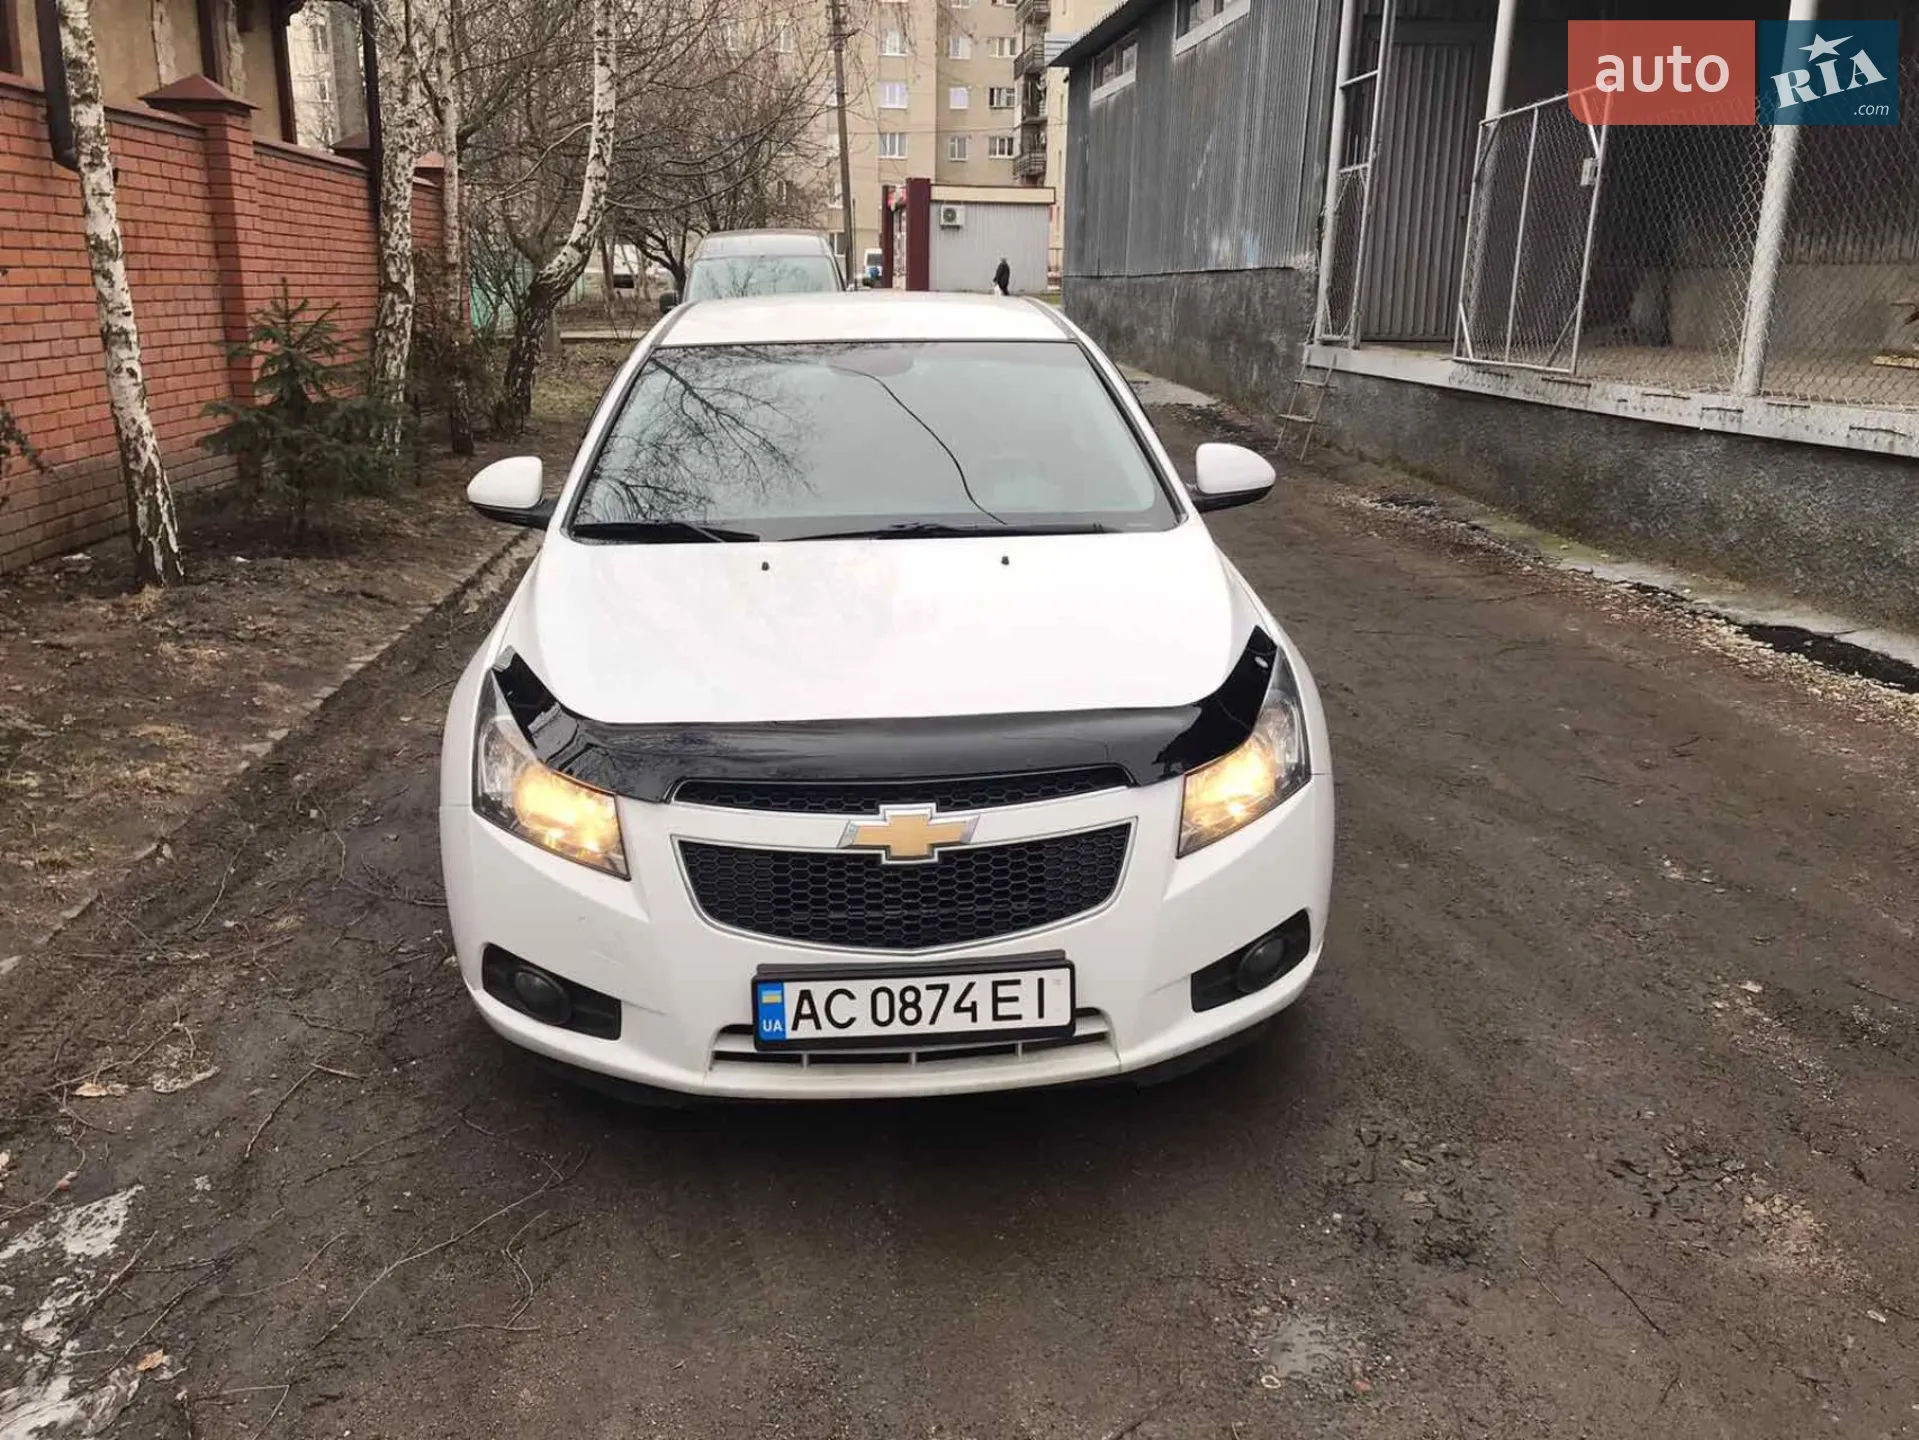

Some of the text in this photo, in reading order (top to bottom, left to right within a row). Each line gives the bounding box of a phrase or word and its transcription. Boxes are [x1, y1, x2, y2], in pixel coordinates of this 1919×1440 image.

[791, 977, 1044, 1032] AC 0874 EI
[762, 1020, 784, 1032] UA
